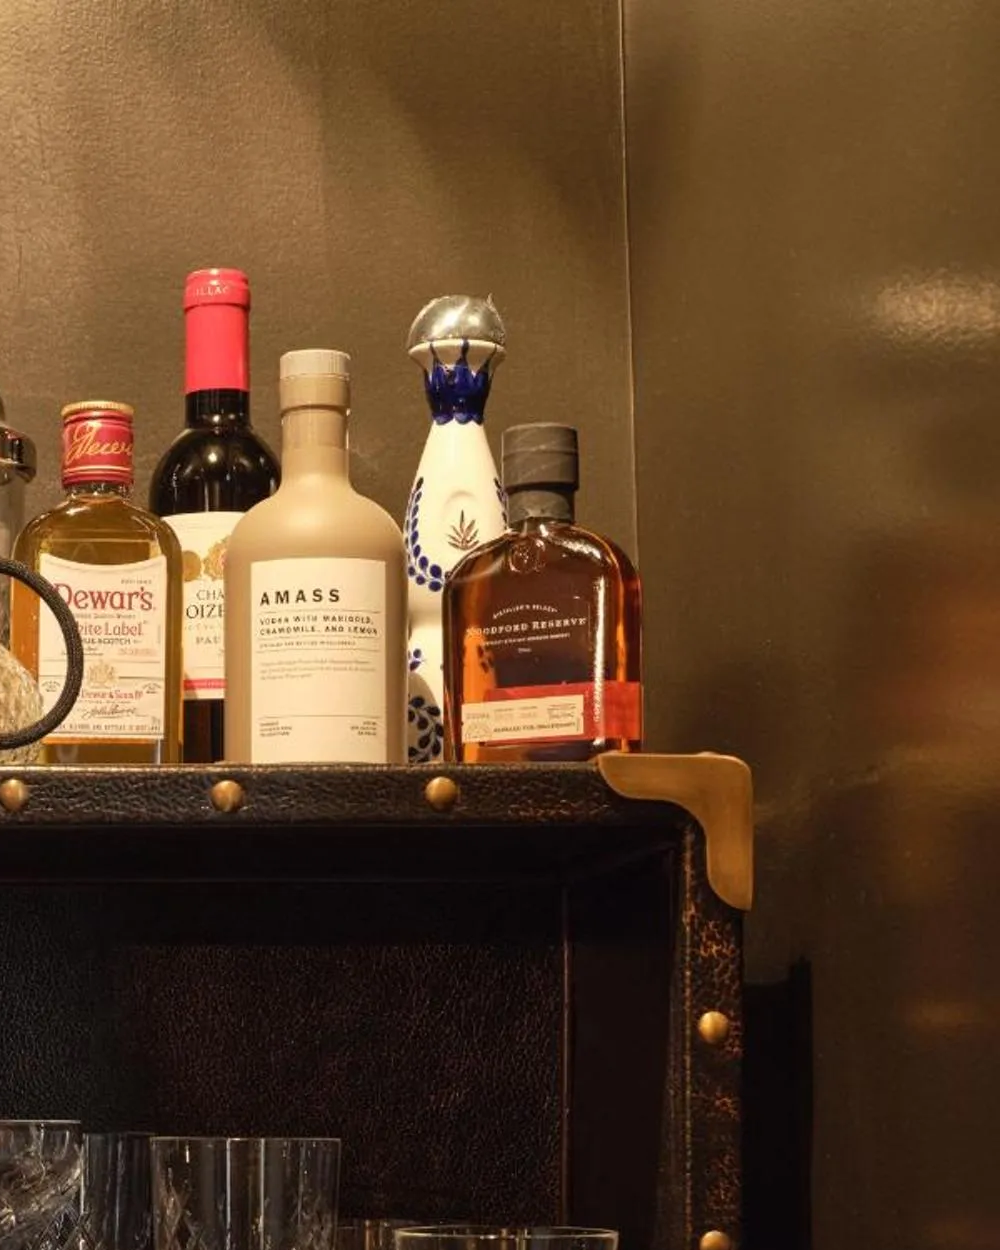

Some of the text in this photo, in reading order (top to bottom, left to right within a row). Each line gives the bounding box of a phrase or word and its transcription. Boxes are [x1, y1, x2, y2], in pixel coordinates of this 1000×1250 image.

[52, 583, 154, 611] Dewar's
[260, 588, 340, 606] AMASS
[260, 617, 289, 626] VODKA
[292, 615, 318, 623] WITH
[531, 617, 587, 630] RESERVE
[78, 621, 144, 636] hite Label
[324, 625, 344, 633] AND
[348, 625, 378, 635] LEMON
